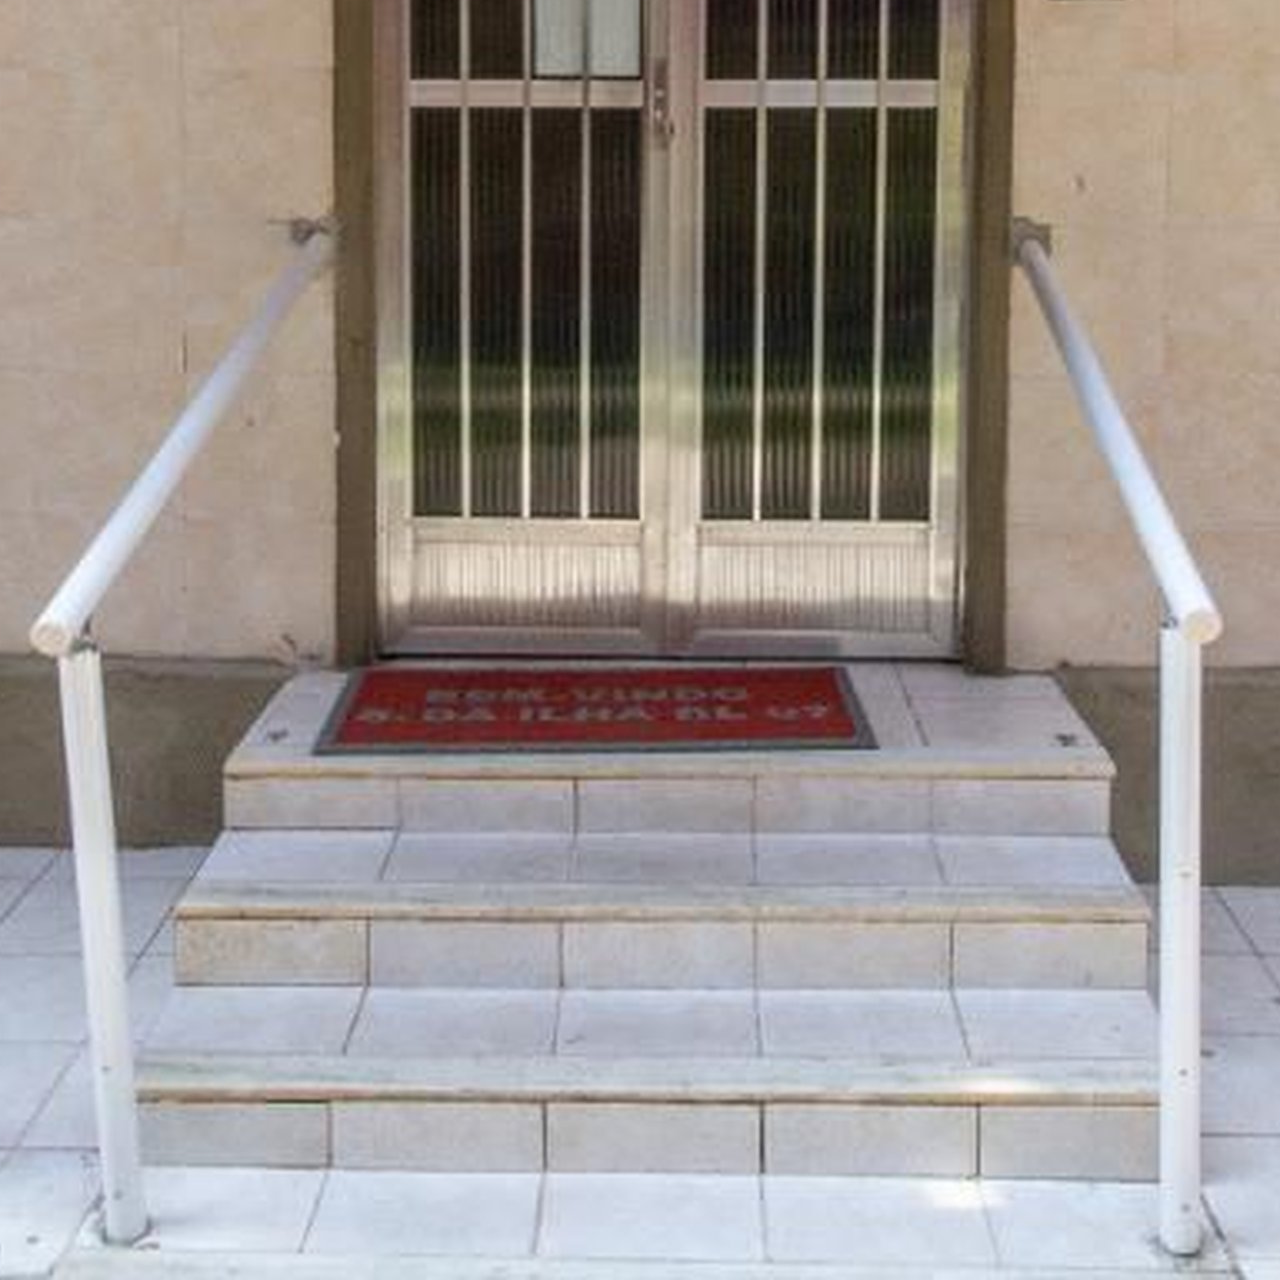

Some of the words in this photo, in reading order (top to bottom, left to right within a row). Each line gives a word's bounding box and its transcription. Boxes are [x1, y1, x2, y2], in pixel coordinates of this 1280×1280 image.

[573, 686, 748, 703] VINDO
[422, 706, 494, 722] DA
[518, 705, 650, 722] ILHA
